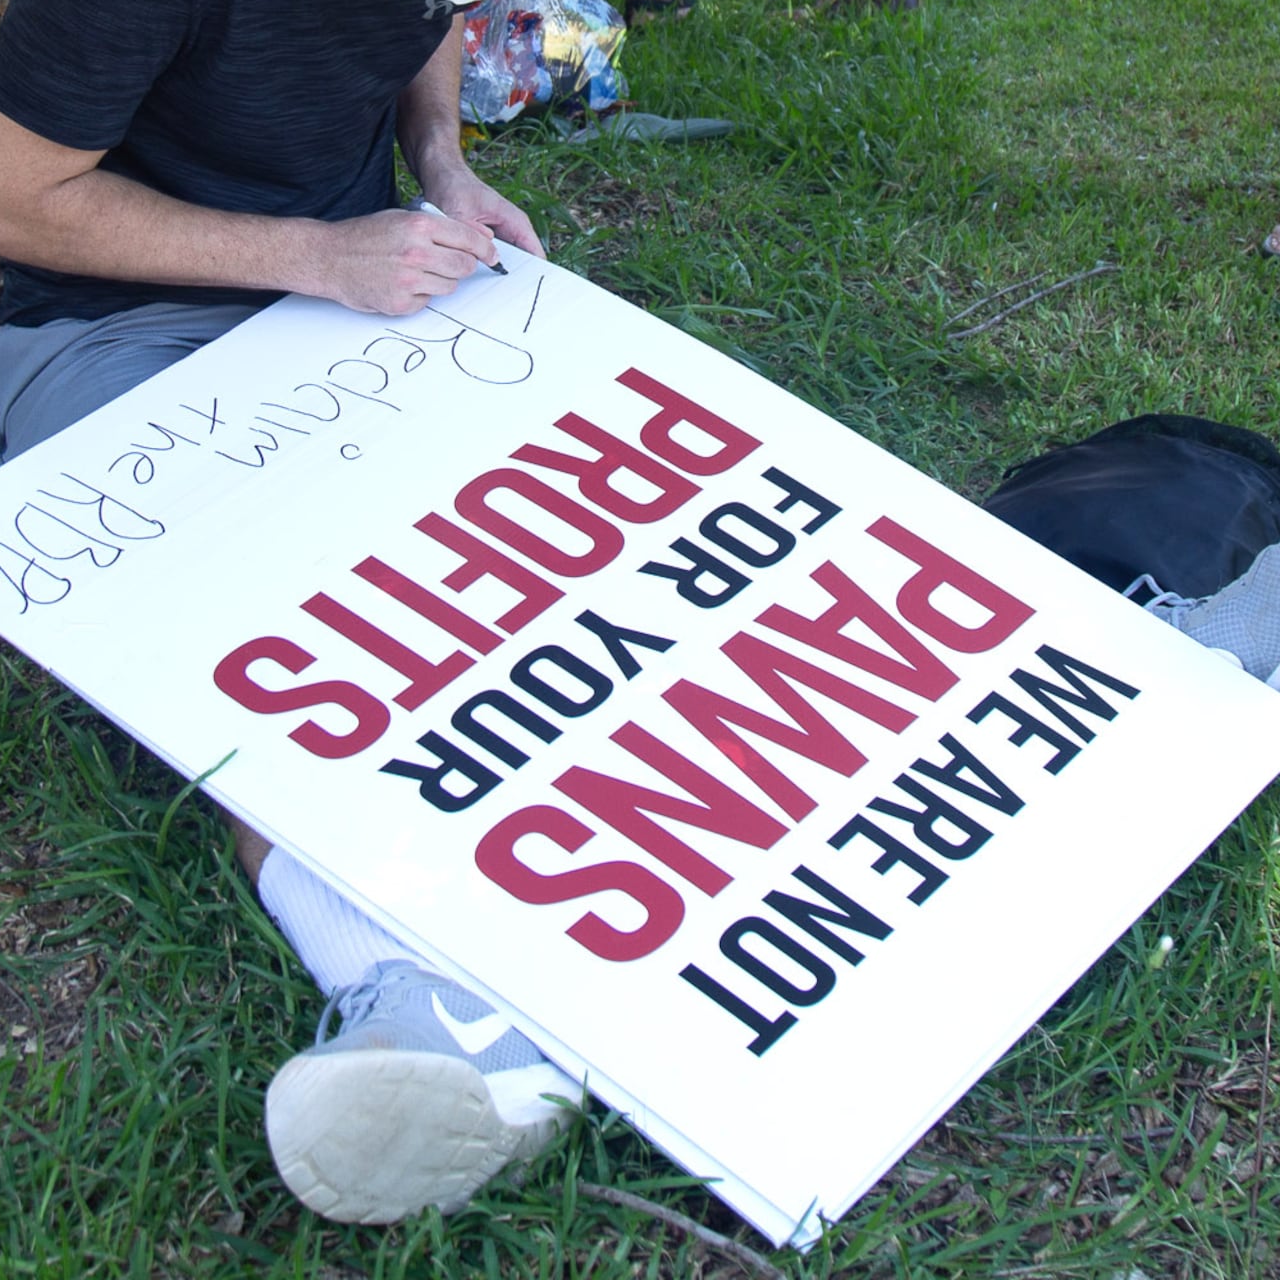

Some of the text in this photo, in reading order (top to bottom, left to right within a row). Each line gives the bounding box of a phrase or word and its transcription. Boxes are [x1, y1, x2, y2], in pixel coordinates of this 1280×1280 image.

[213, 367, 763, 759] PROFITS
[379, 467, 842, 812] FOR YOUR
[475, 516, 1036, 962] PAWNS
[679, 644, 1141, 1057] WE ARE NOT
